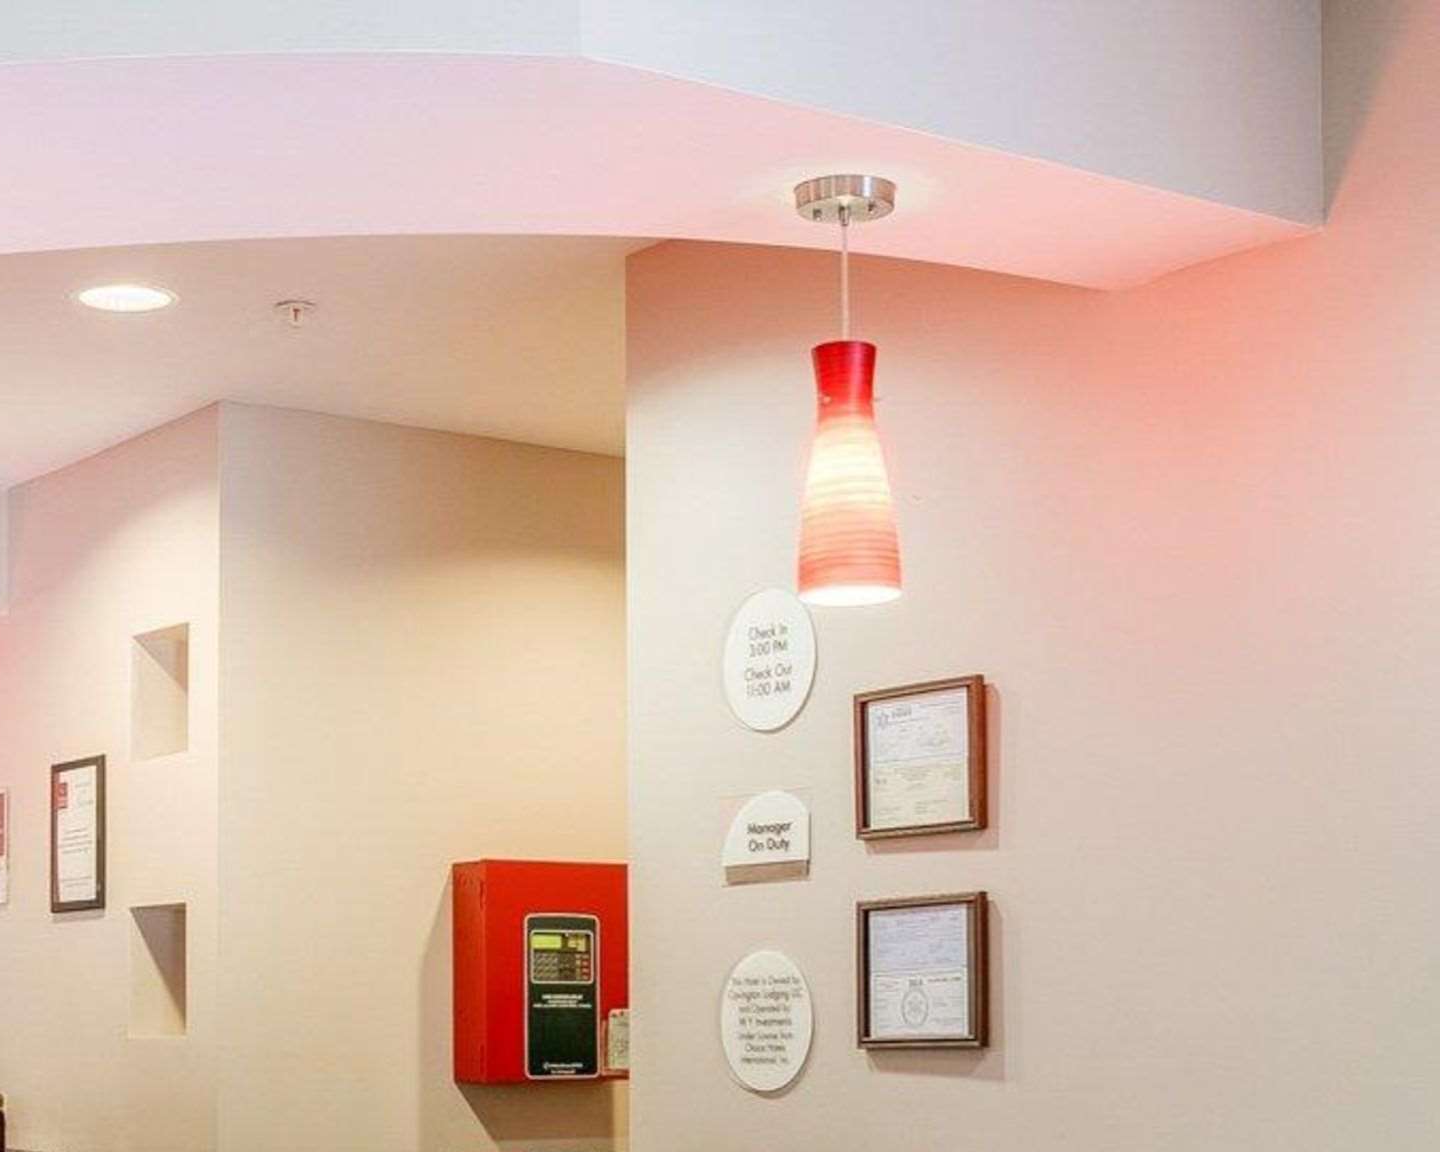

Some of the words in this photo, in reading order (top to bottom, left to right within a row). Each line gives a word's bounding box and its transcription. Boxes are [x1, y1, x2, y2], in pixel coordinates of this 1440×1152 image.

[748, 624, 776, 641] Check
[744, 664, 772, 681] Check
[774, 680, 791, 694] AM
[747, 822, 792, 836] Manager
[748, 838, 764, 852] On
[766, 837, 790, 852] Duty
